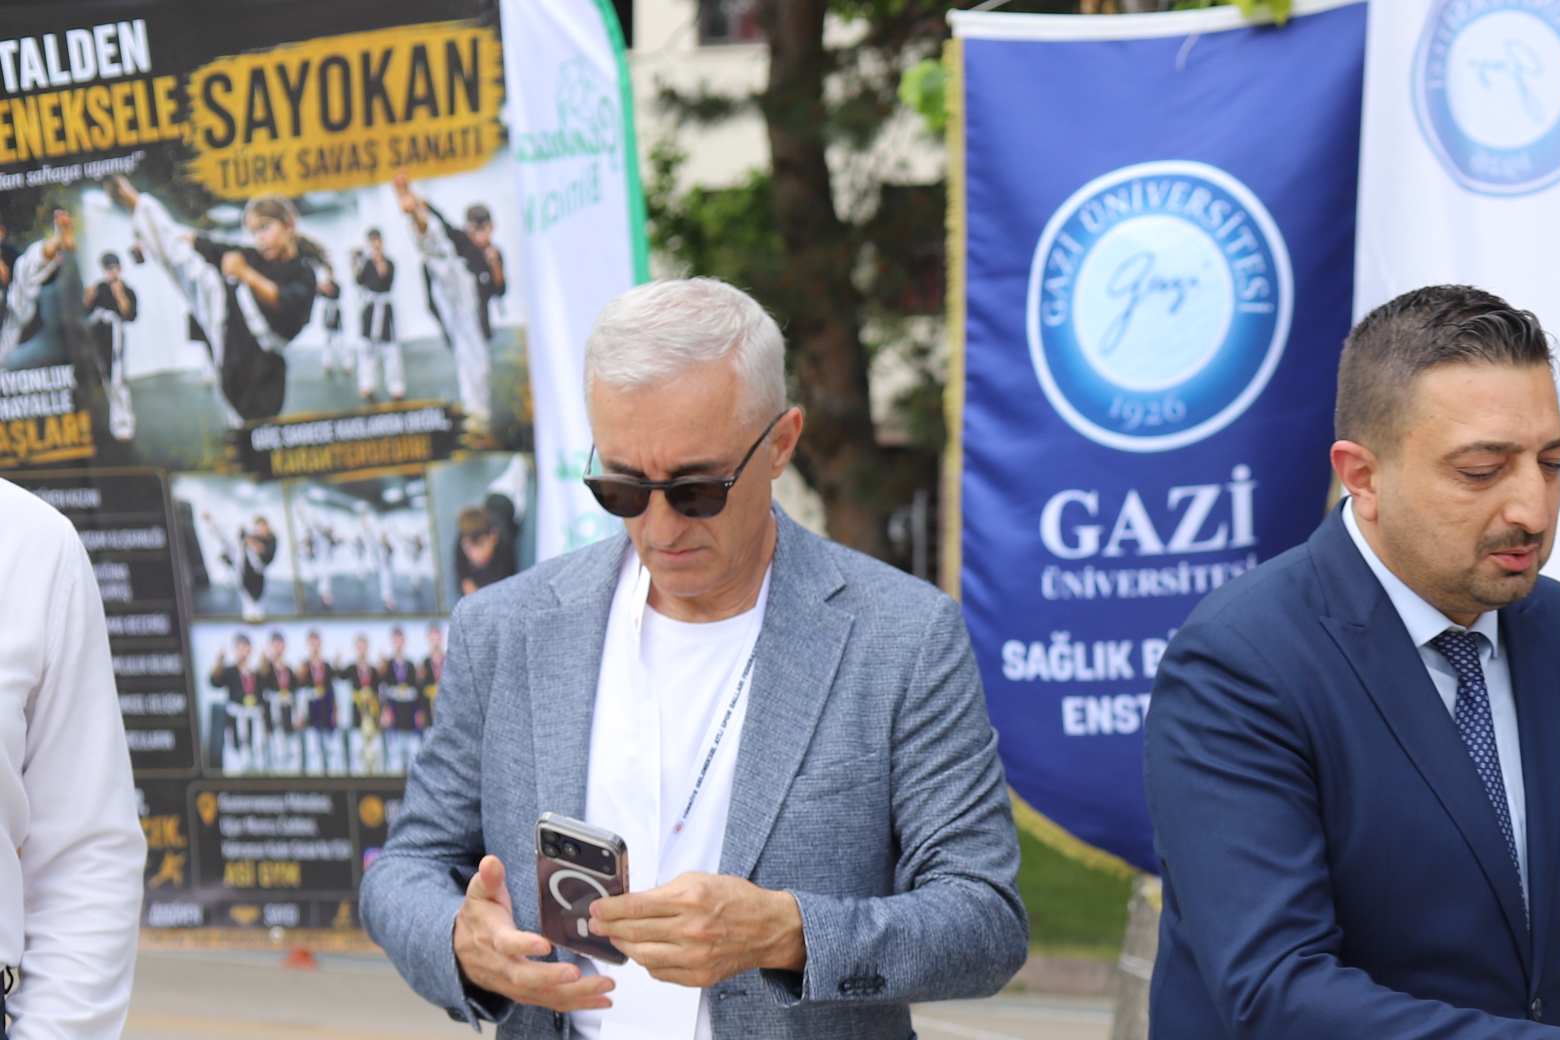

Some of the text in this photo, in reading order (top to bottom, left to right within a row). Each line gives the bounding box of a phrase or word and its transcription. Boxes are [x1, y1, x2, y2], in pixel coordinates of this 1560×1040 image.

[203, 36, 480, 149] SAYOKAN
[219, 150, 286, 190] TÜRK
[297, 139, 379, 178] SAVAŞ
[389, 126, 483, 168] SANATI
[1108, 392, 1188, 431] 1926
[1039, 463, 1259, 560] GAZİ
[1001, 630, 1135, 682] SAĞLIK
